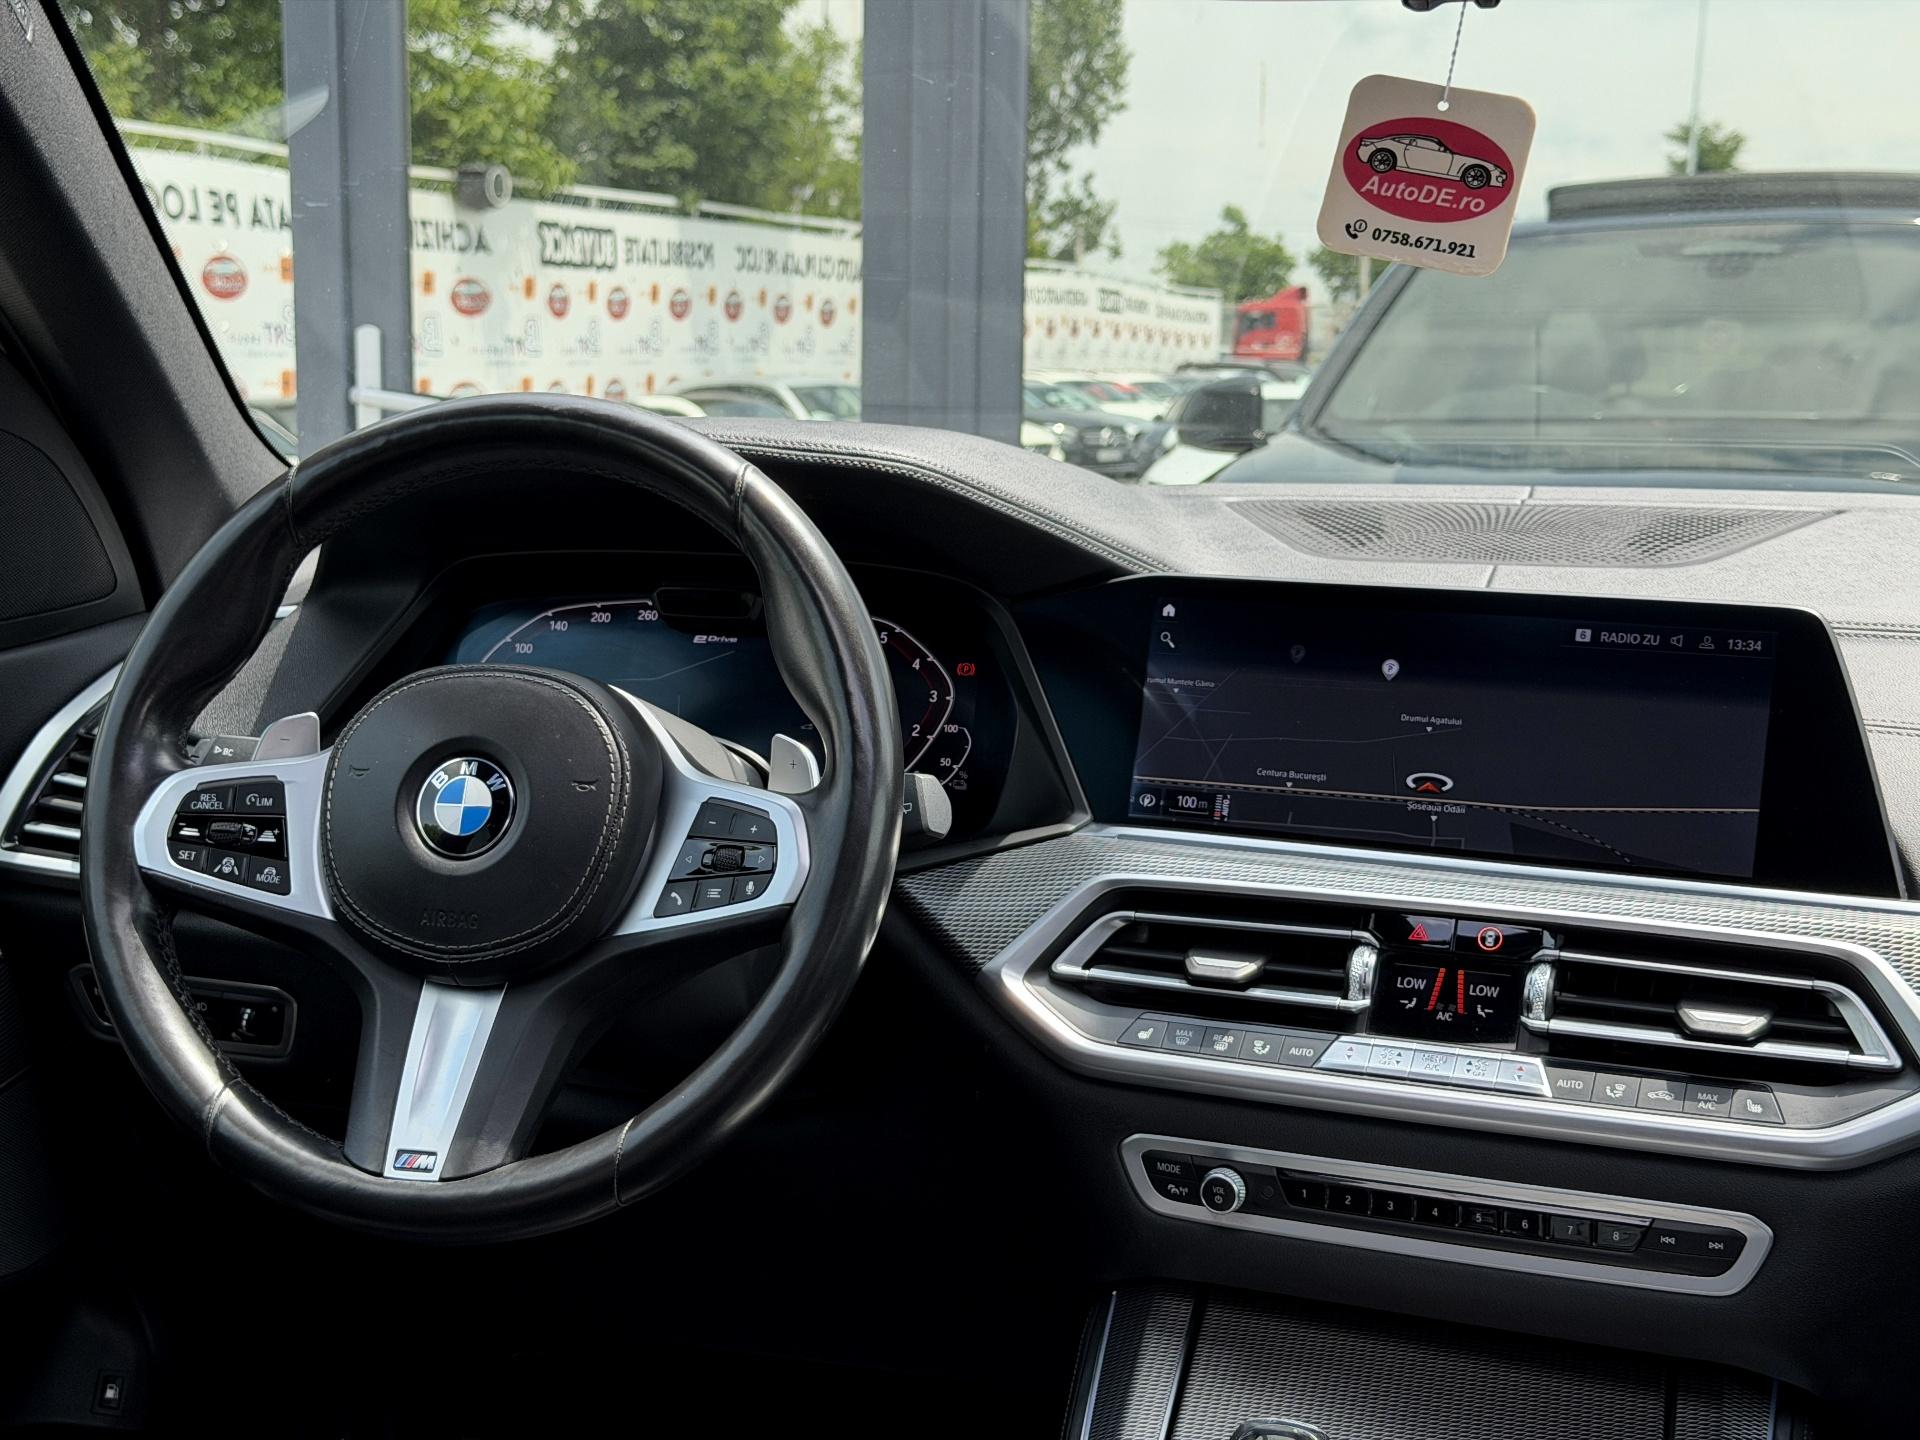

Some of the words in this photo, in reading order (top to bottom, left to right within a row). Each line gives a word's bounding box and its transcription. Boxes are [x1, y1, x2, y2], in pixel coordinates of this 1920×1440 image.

[1360, 175, 1485, 213] AutoDE.ro
[1372, 227, 1476, 259] 0758.671.921
[590, 612, 611, 623] 200
[638, 610, 658, 621] 260
[549, 620, 568, 632] 140
[880, 632, 888, 643] 5
[1600, 632, 1641, 645] RADIO
[1642, 634, 1660, 646] ZU
[514, 643, 533, 654] 100
[1728, 639, 1762, 651] 13:34
[912, 658, 920, 670] 4
[929, 690, 937, 702] 3
[1401, 714, 1428, 723] Drumul
[1430, 715, 1462, 726] Agatului
[912, 724, 920, 737] 2
[943, 725, 959, 733] 100
[222, 747, 234, 757] BC
[940, 758, 951, 767] 50
[431, 761, 505, 792] BMW
[1256, 767, 1287, 779] Centura
[200, 793, 217, 802] RES
[256, 797, 273, 807] LIM
[1177, 795, 1198, 808] 100
[191, 801, 224, 811] CANCEL
[178, 850, 196, 861] SET
[256, 873, 281, 884] MODE
[420, 910, 480, 930] AIRBAG
[1397, 976, 1427, 991] LOW
[1469, 984, 1500, 998] LOW
[1436, 1011, 1454, 1022] A/C
[1175, 1029, 1193, 1038] MAX
[1213, 1034, 1234, 1043] REAR
[1288, 1047, 1314, 1057] AUTO
[1556, 1079, 1583, 1090] AUTO
[1697, 1093, 1718, 1102] MAX
[1697, 1101, 1716, 1111] A/C
[1157, 1162, 1181, 1174] MODE
[1302, 1188, 1307, 1199] 1
[1344, 1195, 1351, 1206] 2
[1386, 1201, 1394, 1211] 3
[1431, 1207, 1439, 1217] 4
[1475, 1212, 1482, 1223] 5
[1521, 1219, 1529, 1230] 6
[1567, 1225, 1574, 1235] 7
[1612, 1231, 1620, 1241] 8
